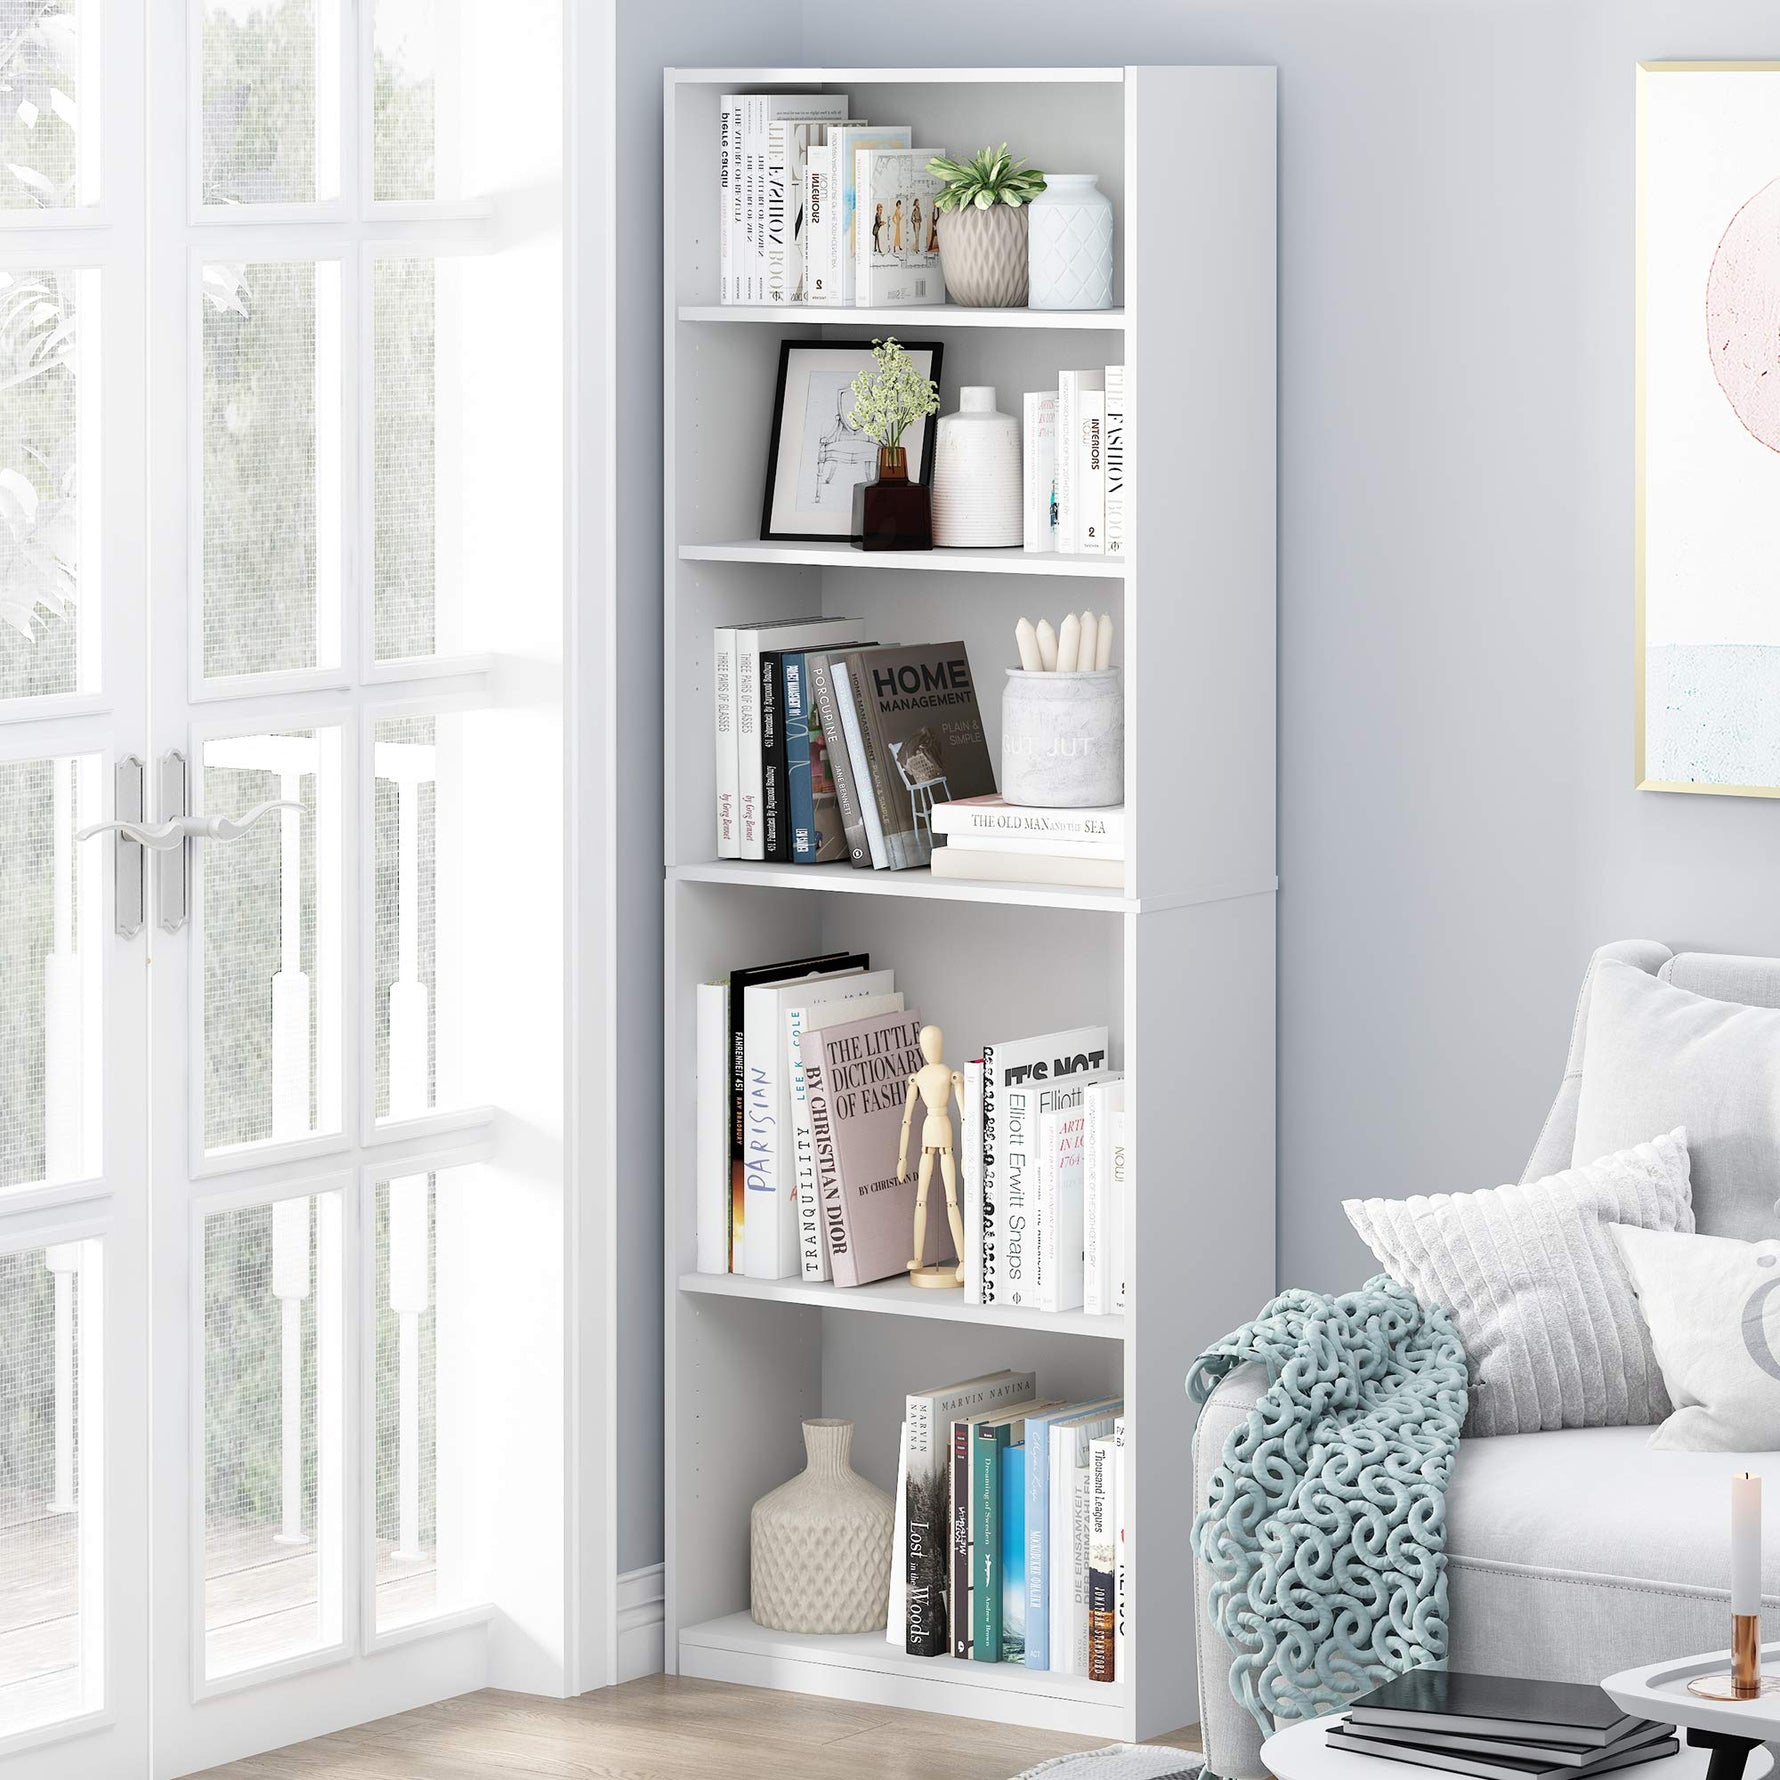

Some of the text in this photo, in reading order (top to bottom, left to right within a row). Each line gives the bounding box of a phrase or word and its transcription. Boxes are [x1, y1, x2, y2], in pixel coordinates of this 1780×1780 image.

[1107, 368, 1123, 407] THE
[1091, 418, 1100, 470] INTERIORS
[1107, 413, 1123, 493] FASHION
[1088, 527, 1096, 538] 2
[717, 652, 730, 732] THREE PAIRS OF GLASSES
[740, 653, 753, 734] THREE PAIRS OF GLASSES
[872, 659, 970, 698] HOME
[813, 668, 838, 743] PORCUPINE
[852, 673, 862, 699] HOME
[857, 700, 875, 761] MANAGEMENT
[879, 691, 972, 713] MANAGEMENT
[942, 719, 979, 733] PLAIN &
[949, 732, 981, 746] SIMPLE
[1047, 737, 1094, 757] JUT
[719, 793, 732, 801] by
[742, 795, 755, 803] by
[834, 765, 852, 816] JANE BENNETT
[971, 813, 996, 828] THE
[997, 815, 1022, 829] OLD
[1024, 817, 1050, 831] MAN
[1050, 821, 1066, 832] AND
[1084, 819, 1106, 834] SEA
[791, 1011, 801, 1047] COLE
[827, 1021, 921, 1065] THE LITTLE
[734, 1031, 743, 1091] FAHRENHEIT 451
[832, 1047, 929, 1093] DICTIONARY
[1005, 1050, 1105, 1087] IT'S NOT
[795, 1077, 805, 1101] LEE
[836, 1080, 920, 1120] OF FASHI
[744, 1068, 776, 1192] PARISIAN
[806, 1066, 848, 1256] BY CHRISTIAN DIOR
[797, 1127, 818, 1272] TRANQUILITY
[858, 1185, 869, 1196] BY
[1006, 1093, 1026, 1280] Elliott Erwitt Snaps
[942, 1381, 1031, 1411] MARVIN NAVINA
[983, 1458, 992, 1499] Dreaming
[1094, 1450, 1105, 1532] Thousand Leagues
[985, 1501, 991, 1511] of
[1074, 1486, 1082, 1575] EINSAMKEIT
[910, 1520, 929, 1644] Lost in the Woods
[1094, 1586, 1105, 1628] JONATHAN
